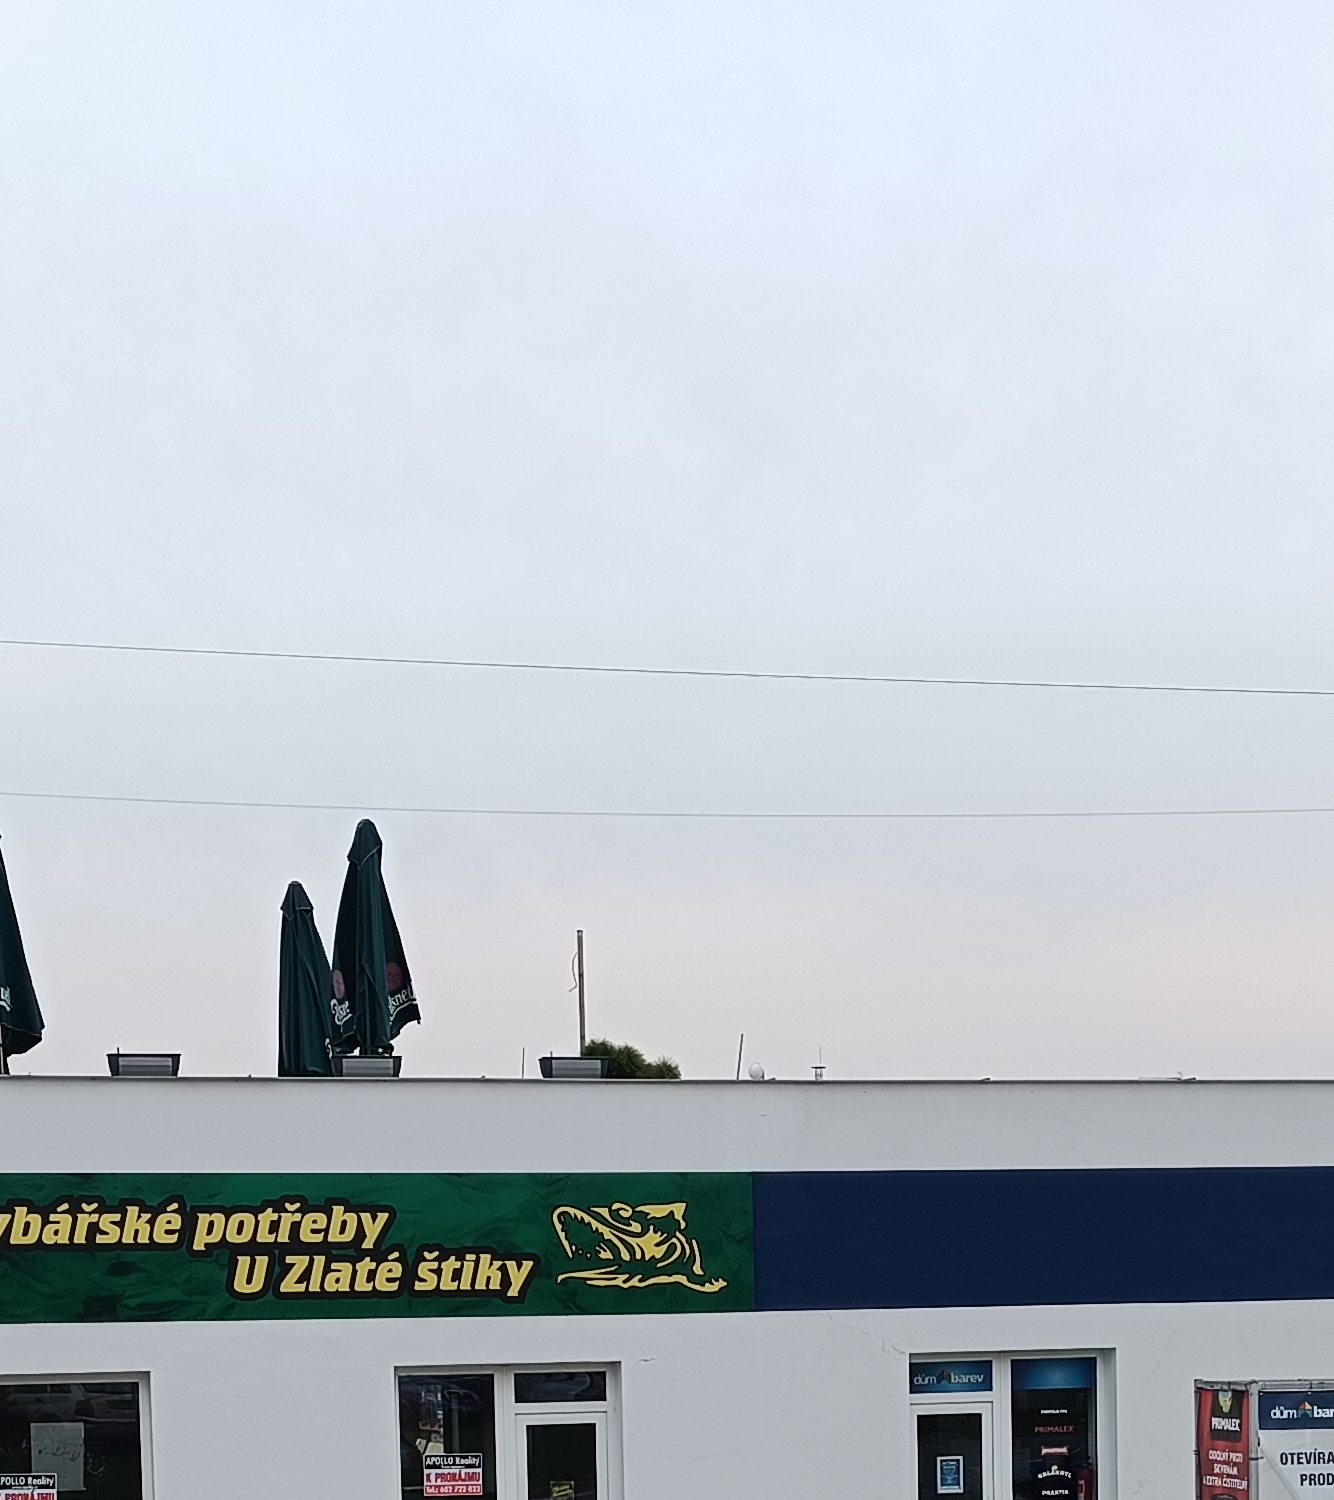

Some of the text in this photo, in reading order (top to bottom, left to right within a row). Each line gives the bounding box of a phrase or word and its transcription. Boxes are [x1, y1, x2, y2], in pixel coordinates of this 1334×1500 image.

[192, 1202, 389, 1250] potřeby
[233, 1250, 534, 1297] U Zlaté štiky
[951, 1372, 984, 1383] barev
[1270, 1404, 1297, 1419] dům
[1034, 1425, 1074, 1433] PRIMALEX
[426, 1457, 453, 1466] APOLLO
[426, 1473, 431, 1483] K
